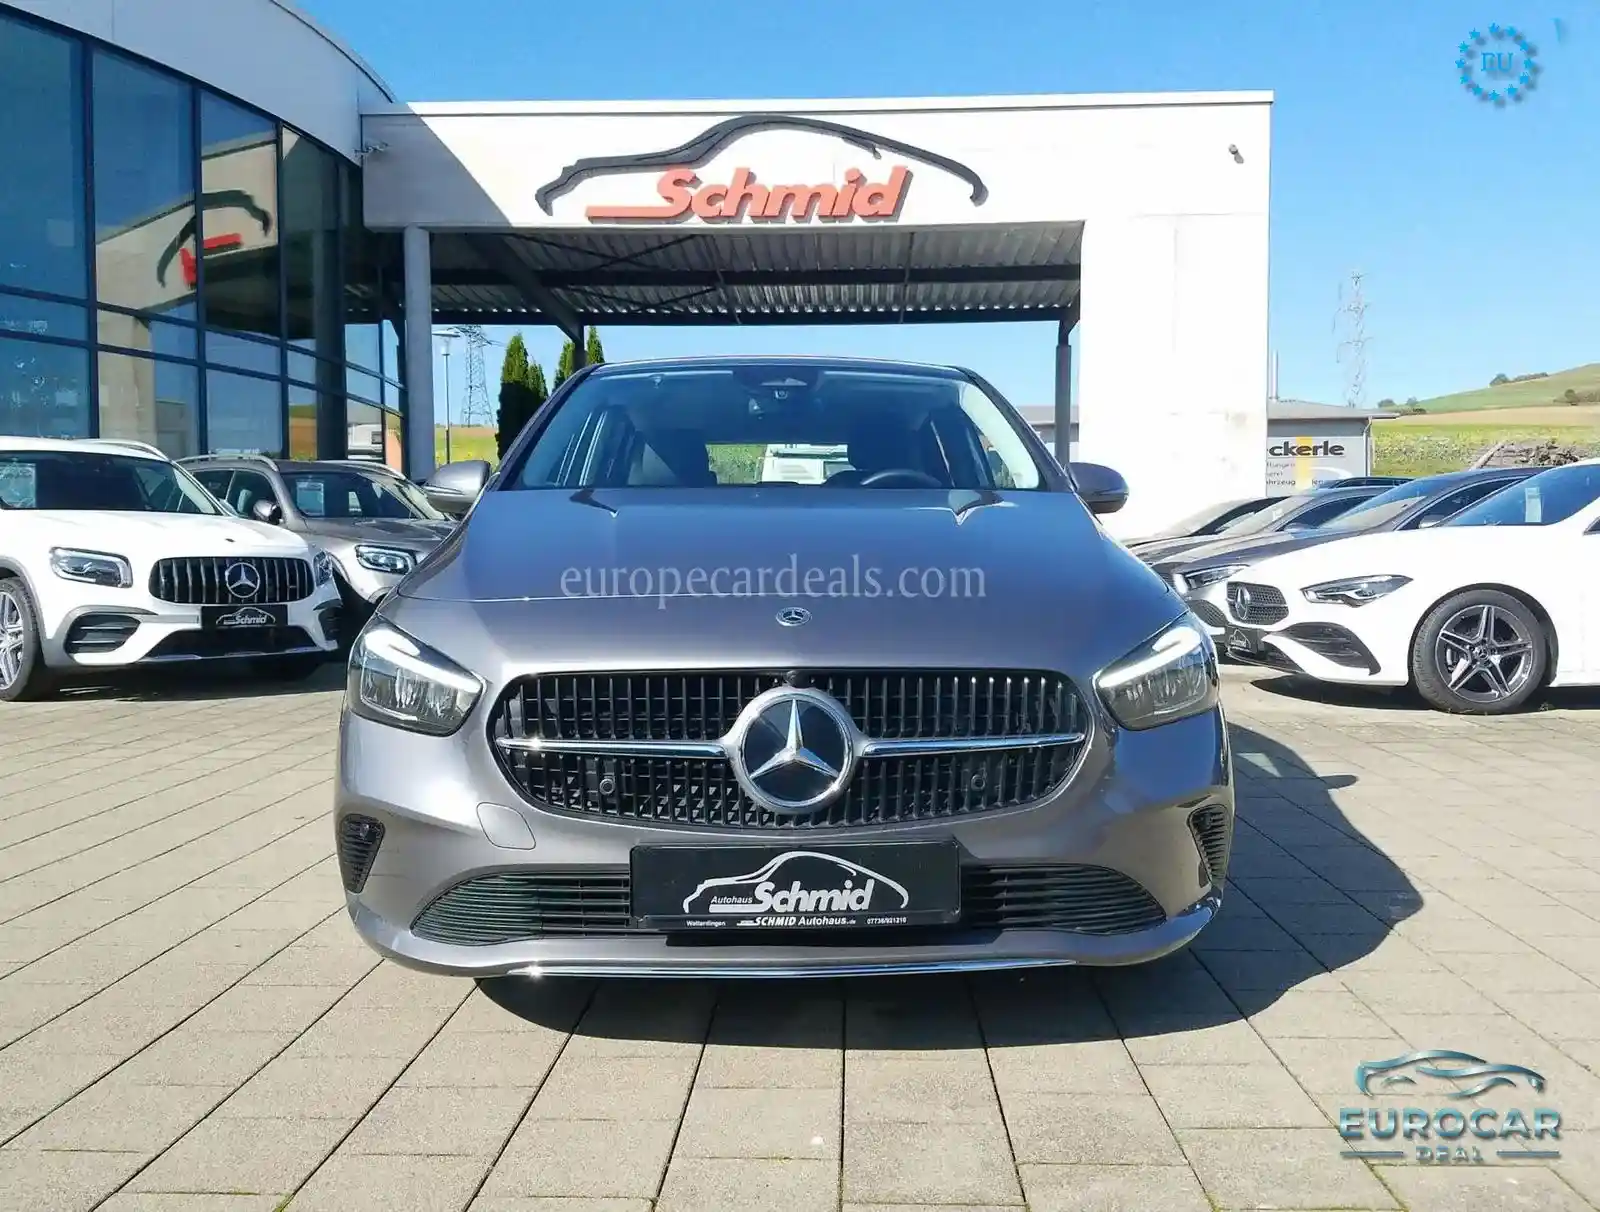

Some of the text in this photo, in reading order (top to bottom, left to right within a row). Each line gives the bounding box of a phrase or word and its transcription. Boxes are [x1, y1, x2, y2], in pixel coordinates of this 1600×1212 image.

[586, 165, 908, 217] Schmid
[1267, 441, 1345, 456] ckerle
[223, 614, 267, 625] Schmid
[709, 879, 875, 913] Autohaus Schmid
[738, 916, 797, 926] SCHMID
